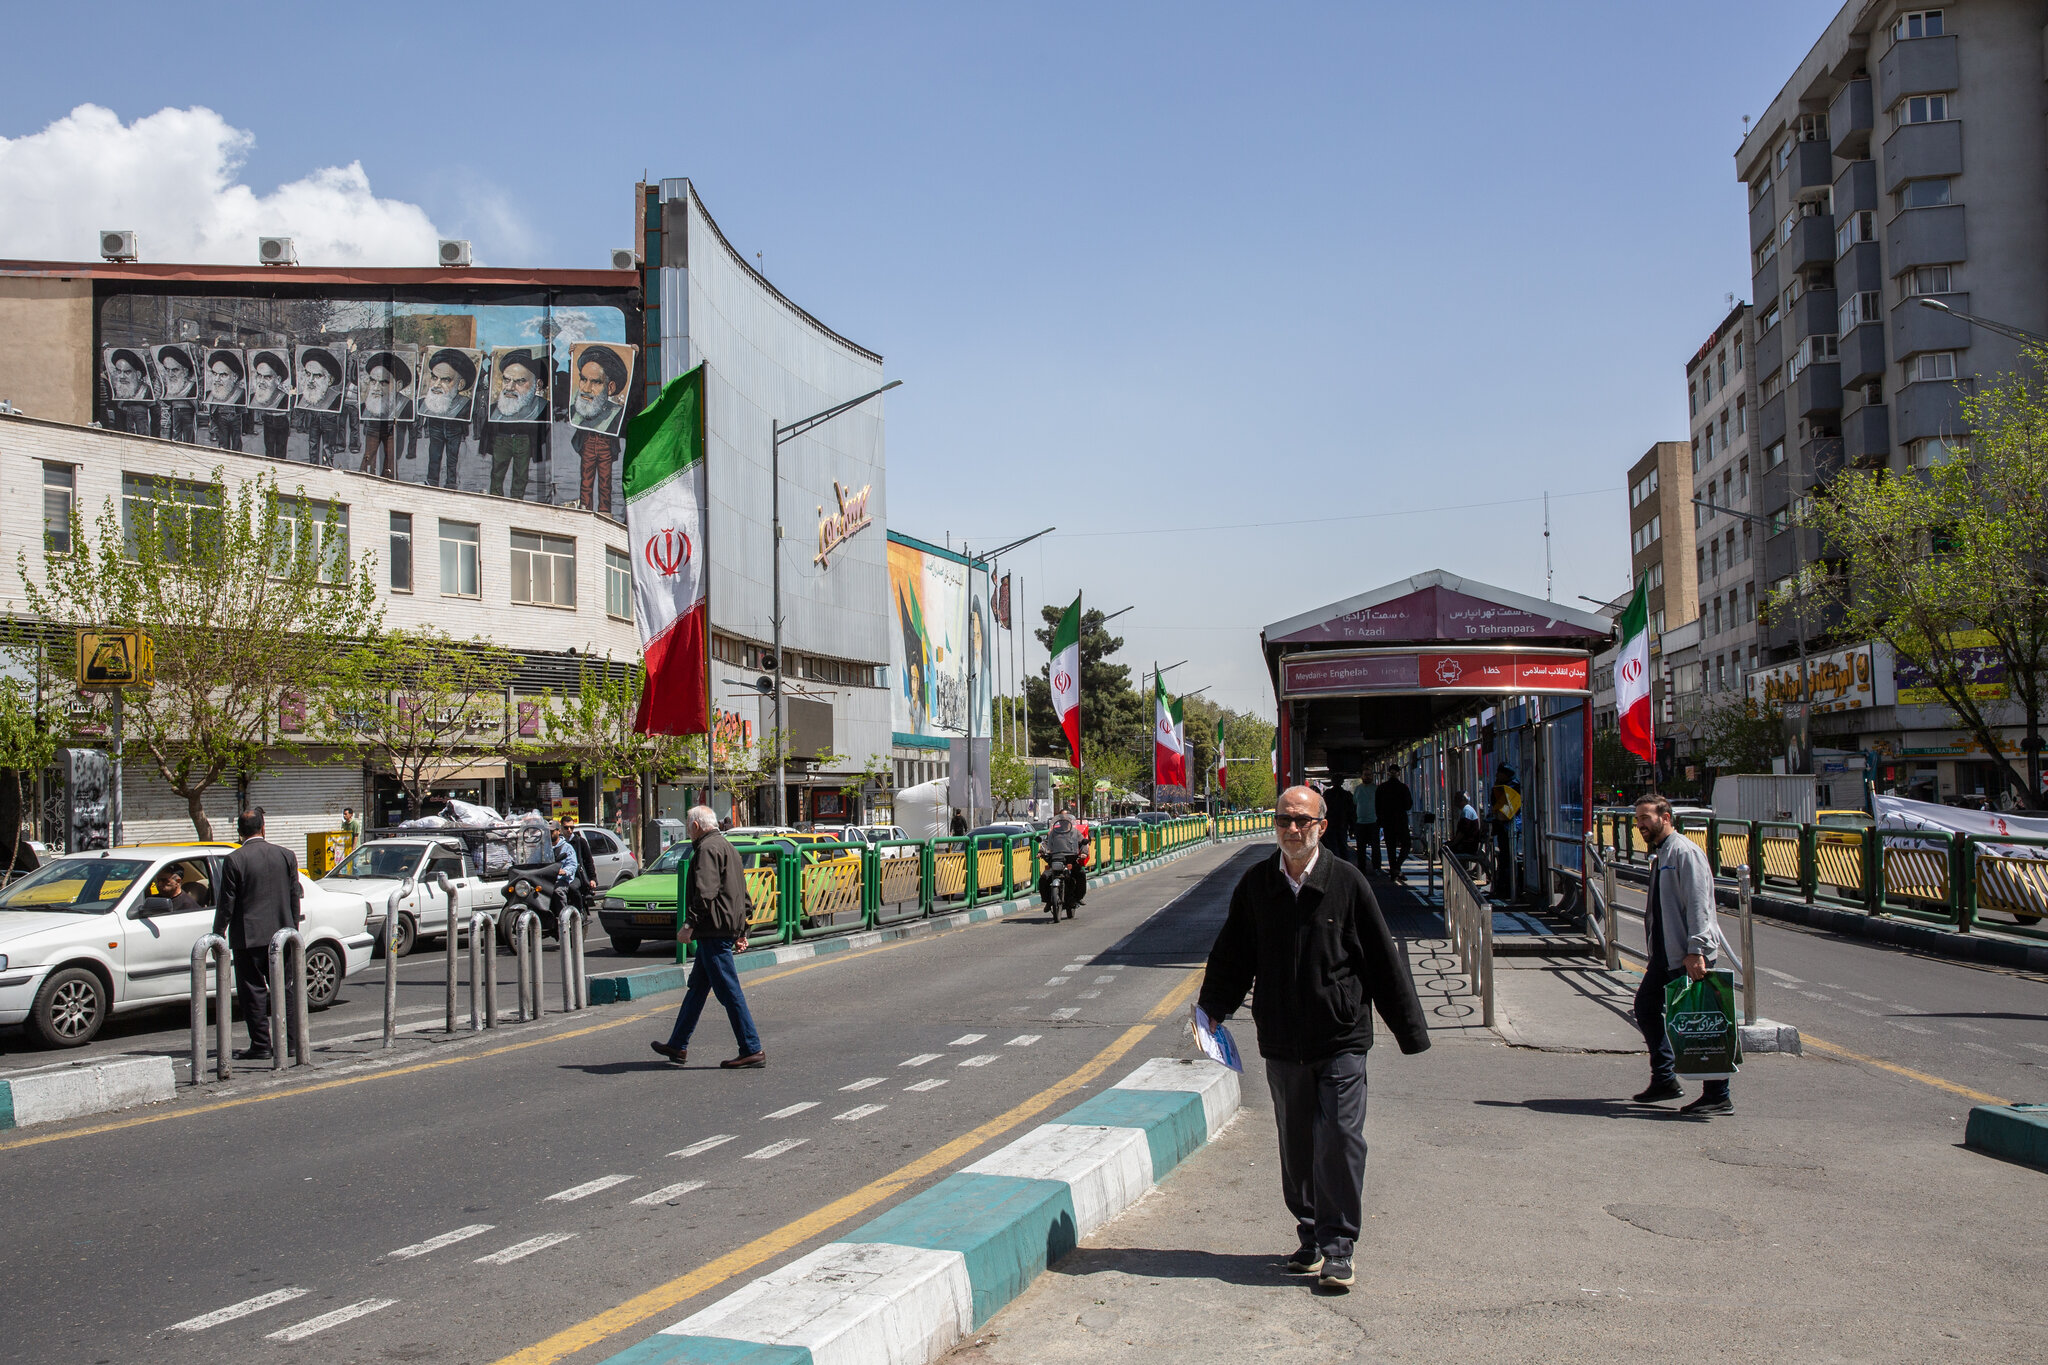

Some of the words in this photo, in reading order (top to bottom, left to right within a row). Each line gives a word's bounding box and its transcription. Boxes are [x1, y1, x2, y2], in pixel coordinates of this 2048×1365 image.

[1342, 609, 1371, 622] آزادی
[1371, 611, 1397, 619] سمت
[1343, 627, 1355, 636] To
[1358, 626, 1385, 636] Azadi
[1465, 625, 1477, 634] To
[1479, 624, 1535, 635] Tehranpars
[1295, 670, 1328, 681] Meydan-e
[1329, 667, 1369, 679] Enghelab
[1522, 666, 1547, 677] اسلامی
[1547, 666, 1569, 677] انقلاب
[1568, 667, 1586, 678] میدان
